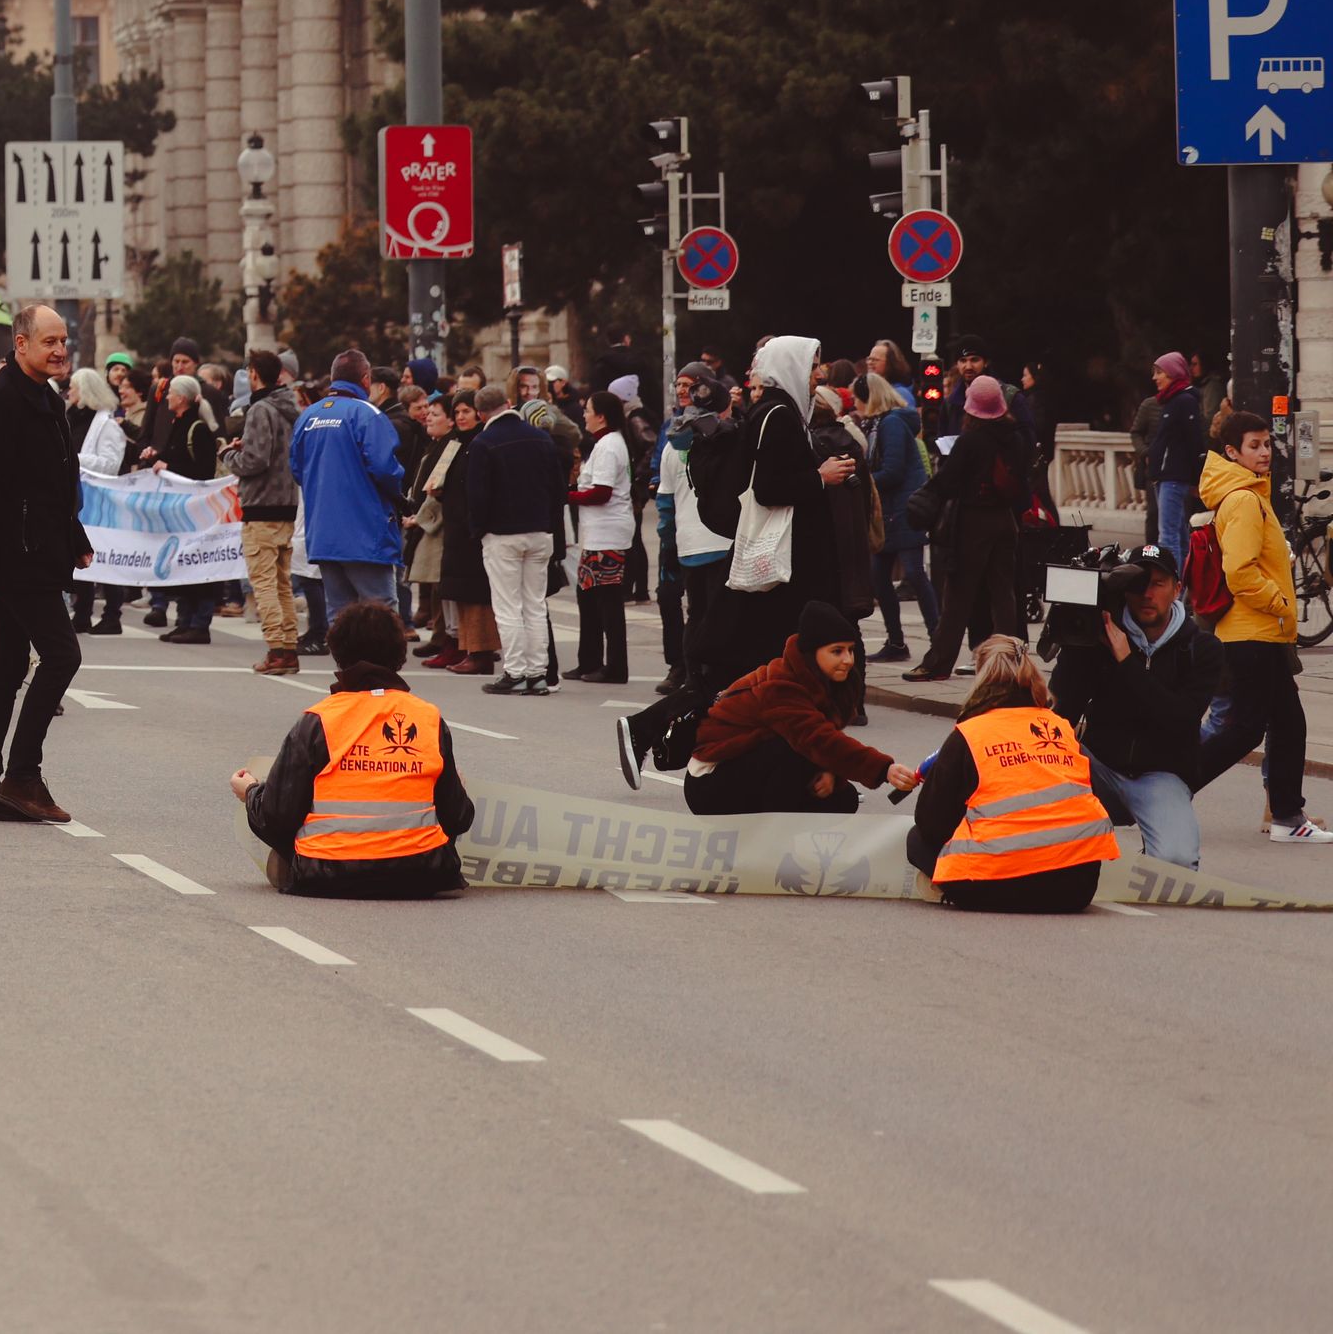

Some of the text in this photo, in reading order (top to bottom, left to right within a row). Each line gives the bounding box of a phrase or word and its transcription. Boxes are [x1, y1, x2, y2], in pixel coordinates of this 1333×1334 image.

[400, 161, 458, 183] PRATER
[51, 207, 79, 218] 200m
[692, 293, 725, 309] Anfang
[910, 288, 942, 303] Ende
[109, 548, 153, 568] handeln.
[340, 755, 423, 774] GENERATION.AT
